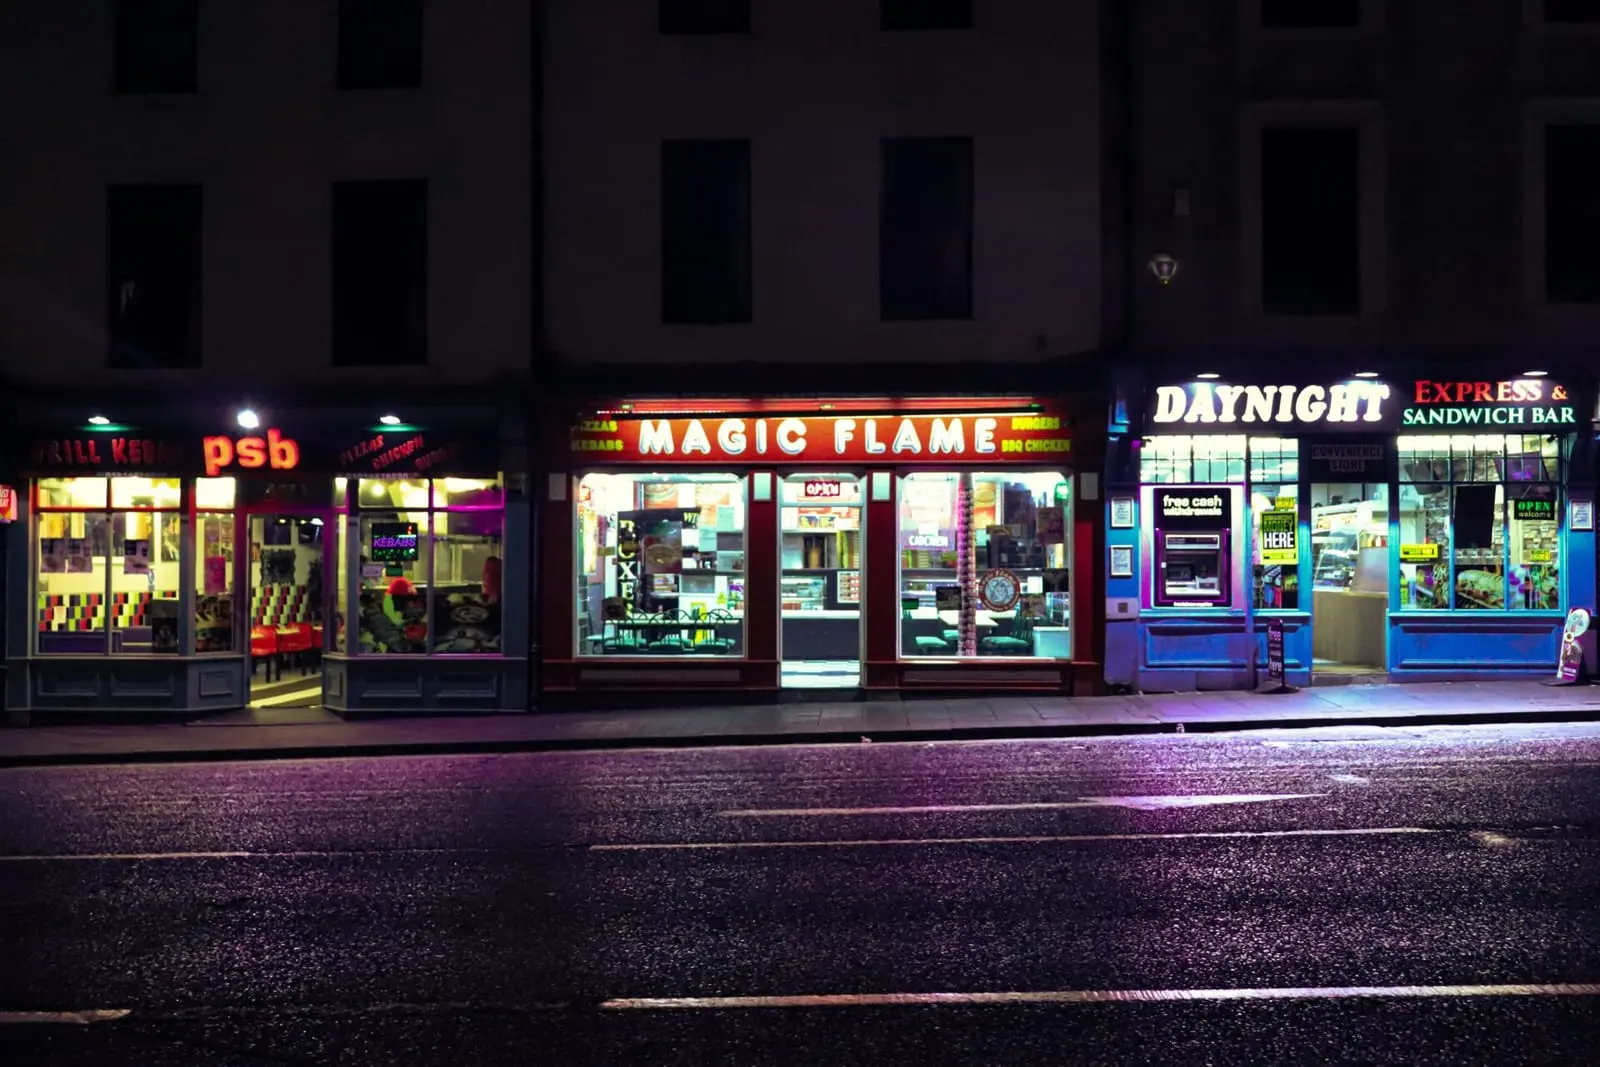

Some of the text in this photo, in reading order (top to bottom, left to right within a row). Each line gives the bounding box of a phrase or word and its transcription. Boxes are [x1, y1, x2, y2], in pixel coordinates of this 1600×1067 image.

[1415, 380, 1568, 403] EXPRESS &
[1153, 385, 1390, 423] DAYNIGHT
[1403, 407, 1576, 425] SANDWICH BAR
[639, 417, 998, 455] MAGIC FLAME
[201, 427, 301, 477] psb
[1001, 439, 1071, 452] BBQ CHICKEN
[1192, 494, 1222, 507] cash
[1518, 501, 1551, 511] OPEN
[1518, 510, 1551, 518] welcome
[1263, 531, 1294, 548] HERE
